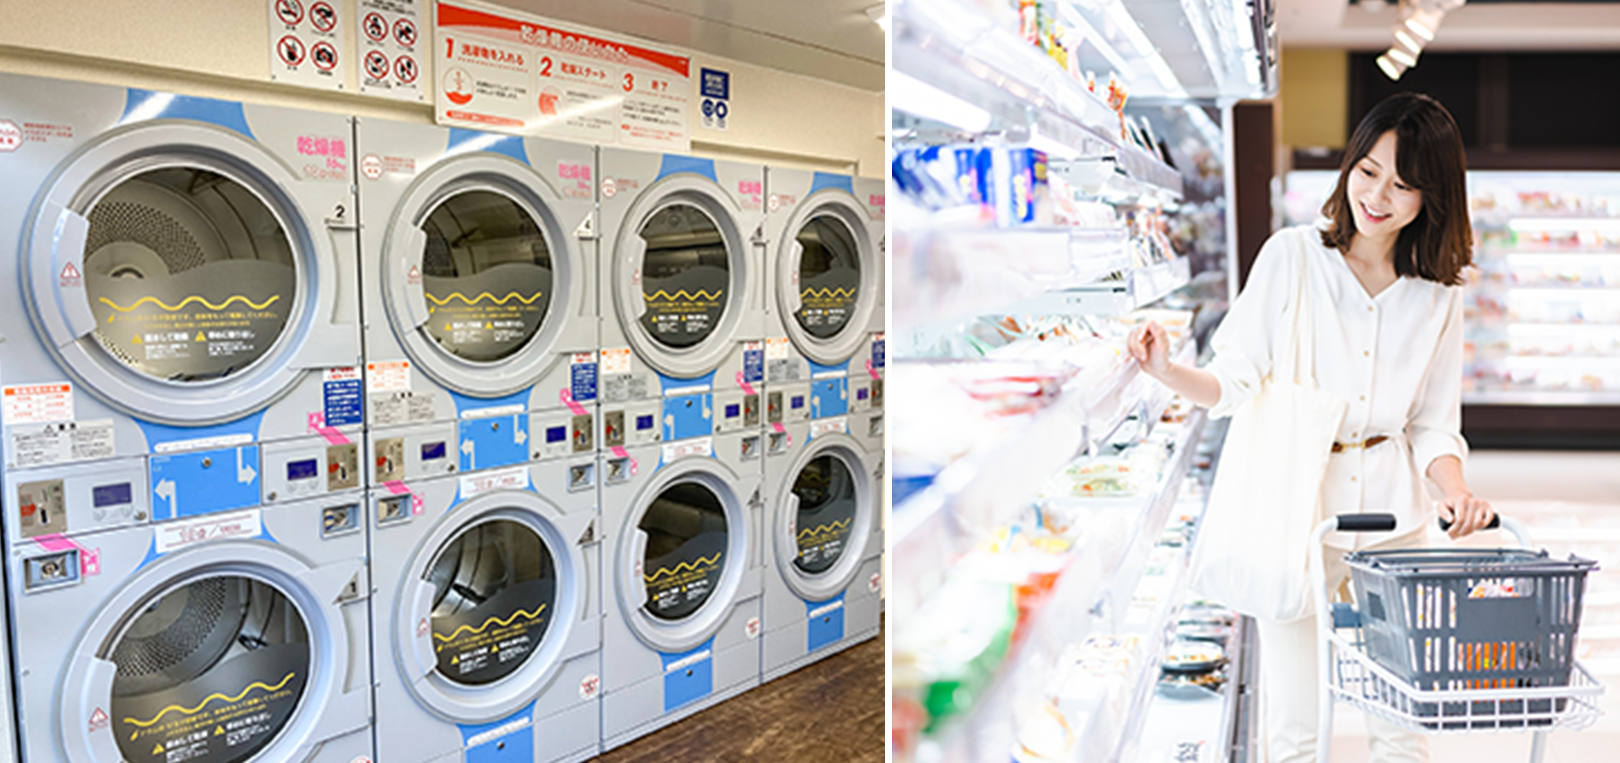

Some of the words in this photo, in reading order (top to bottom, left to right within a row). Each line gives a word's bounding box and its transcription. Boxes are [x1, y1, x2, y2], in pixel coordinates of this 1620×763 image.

[446, 37, 455, 59] 1
[540, 56, 552, 78] 2
[622, 73, 635, 92] 3
[335, 205, 346, 218] 2
